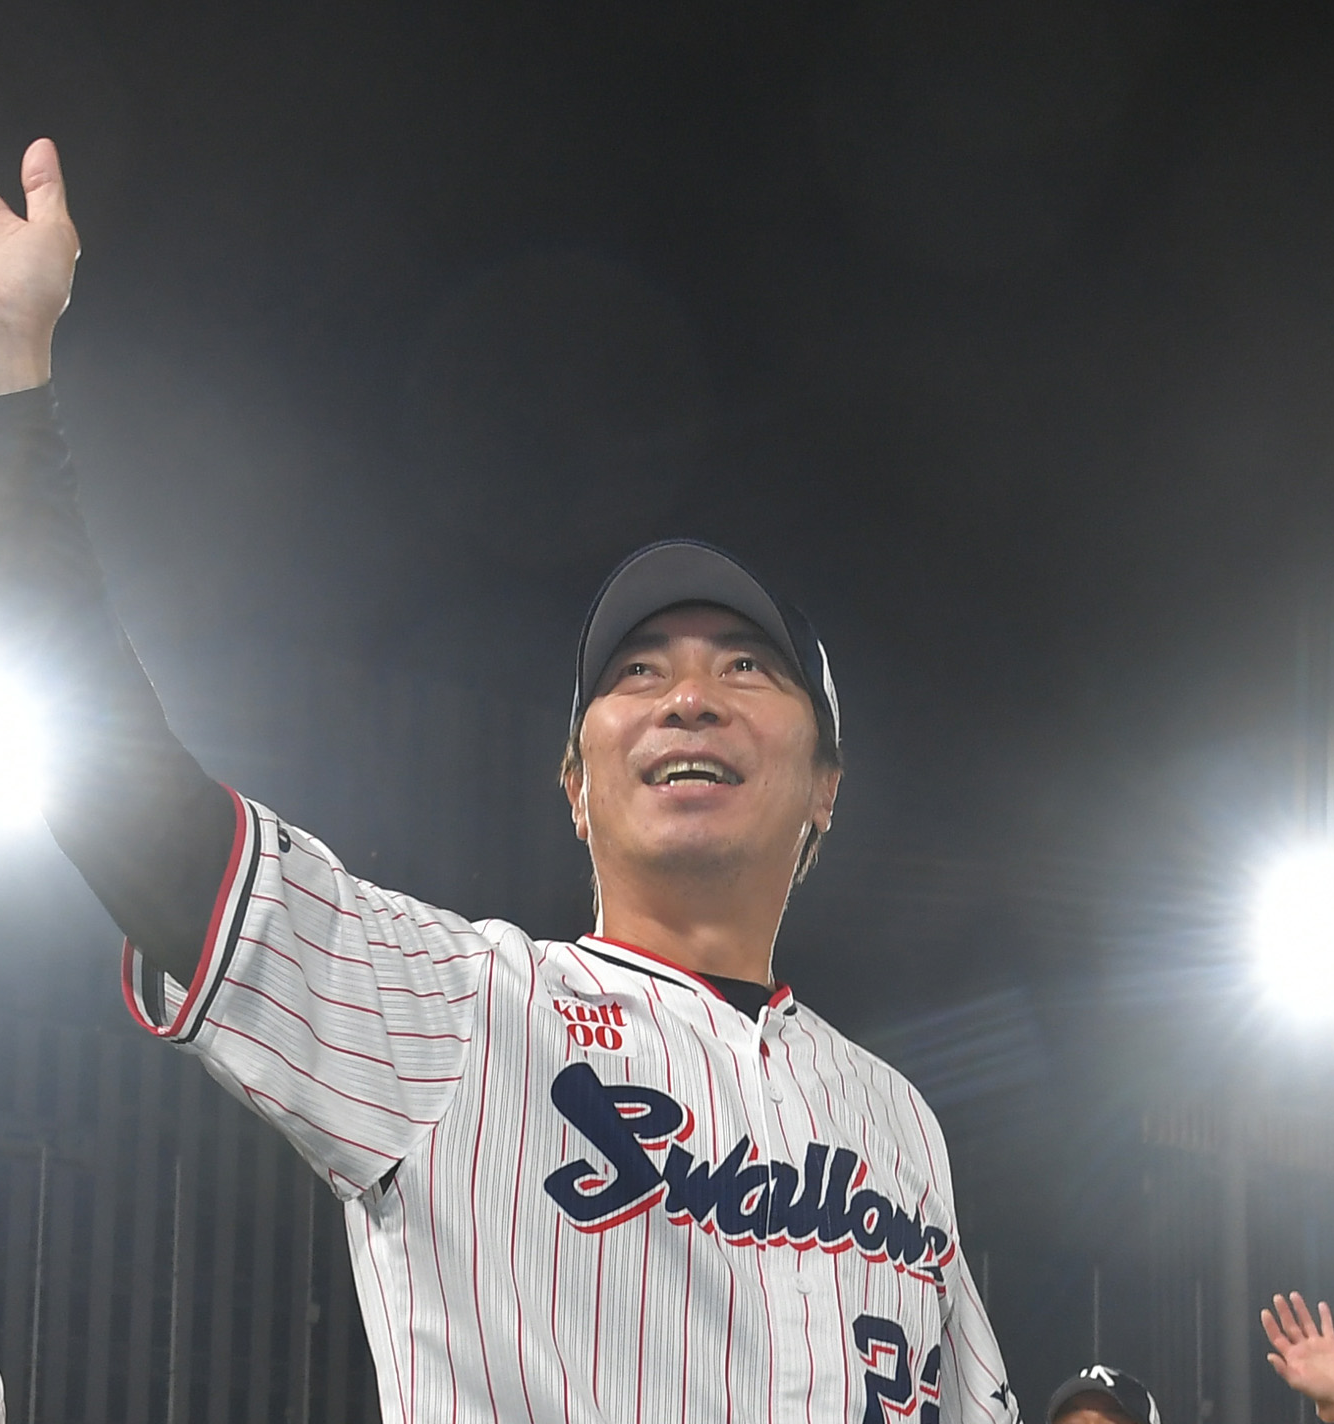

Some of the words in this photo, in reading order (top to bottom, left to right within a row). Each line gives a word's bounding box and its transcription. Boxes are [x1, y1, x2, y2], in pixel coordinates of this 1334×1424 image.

[552, 999, 628, 1027] kult
[566, 1023, 623, 1050] 00
[544, 1062, 955, 1299] Swallows
